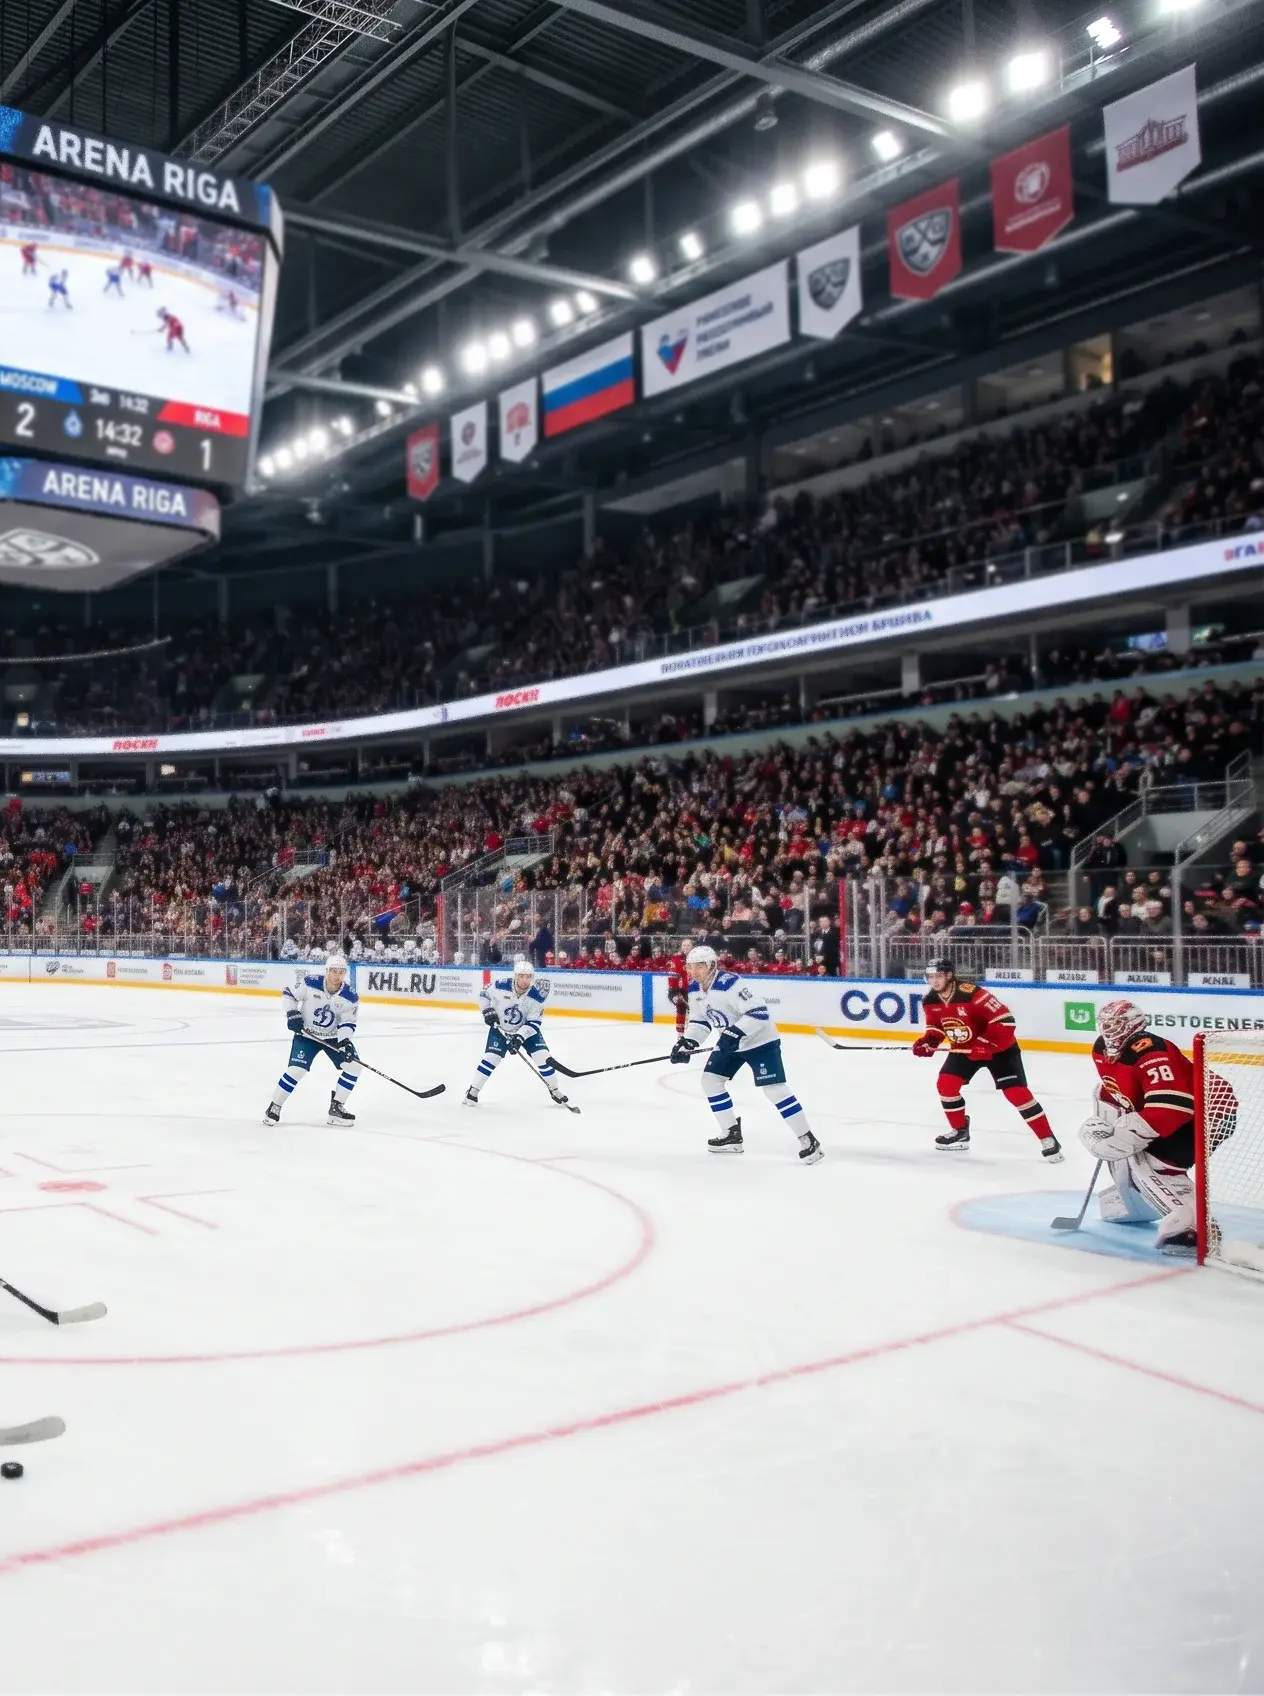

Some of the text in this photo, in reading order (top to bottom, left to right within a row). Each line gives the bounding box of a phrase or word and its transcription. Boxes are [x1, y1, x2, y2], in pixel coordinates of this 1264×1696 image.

[33, 125, 241, 213] ARENA RIGA
[0, 371, 58, 394] MOSCOW
[15, 402, 35, 437] 2
[96, 419, 142, 446] 14:32
[200, 439, 212, 471] 1
[43, 470, 187, 517] ARENA RIGA
[368, 971, 436, 994] KHL.RU
